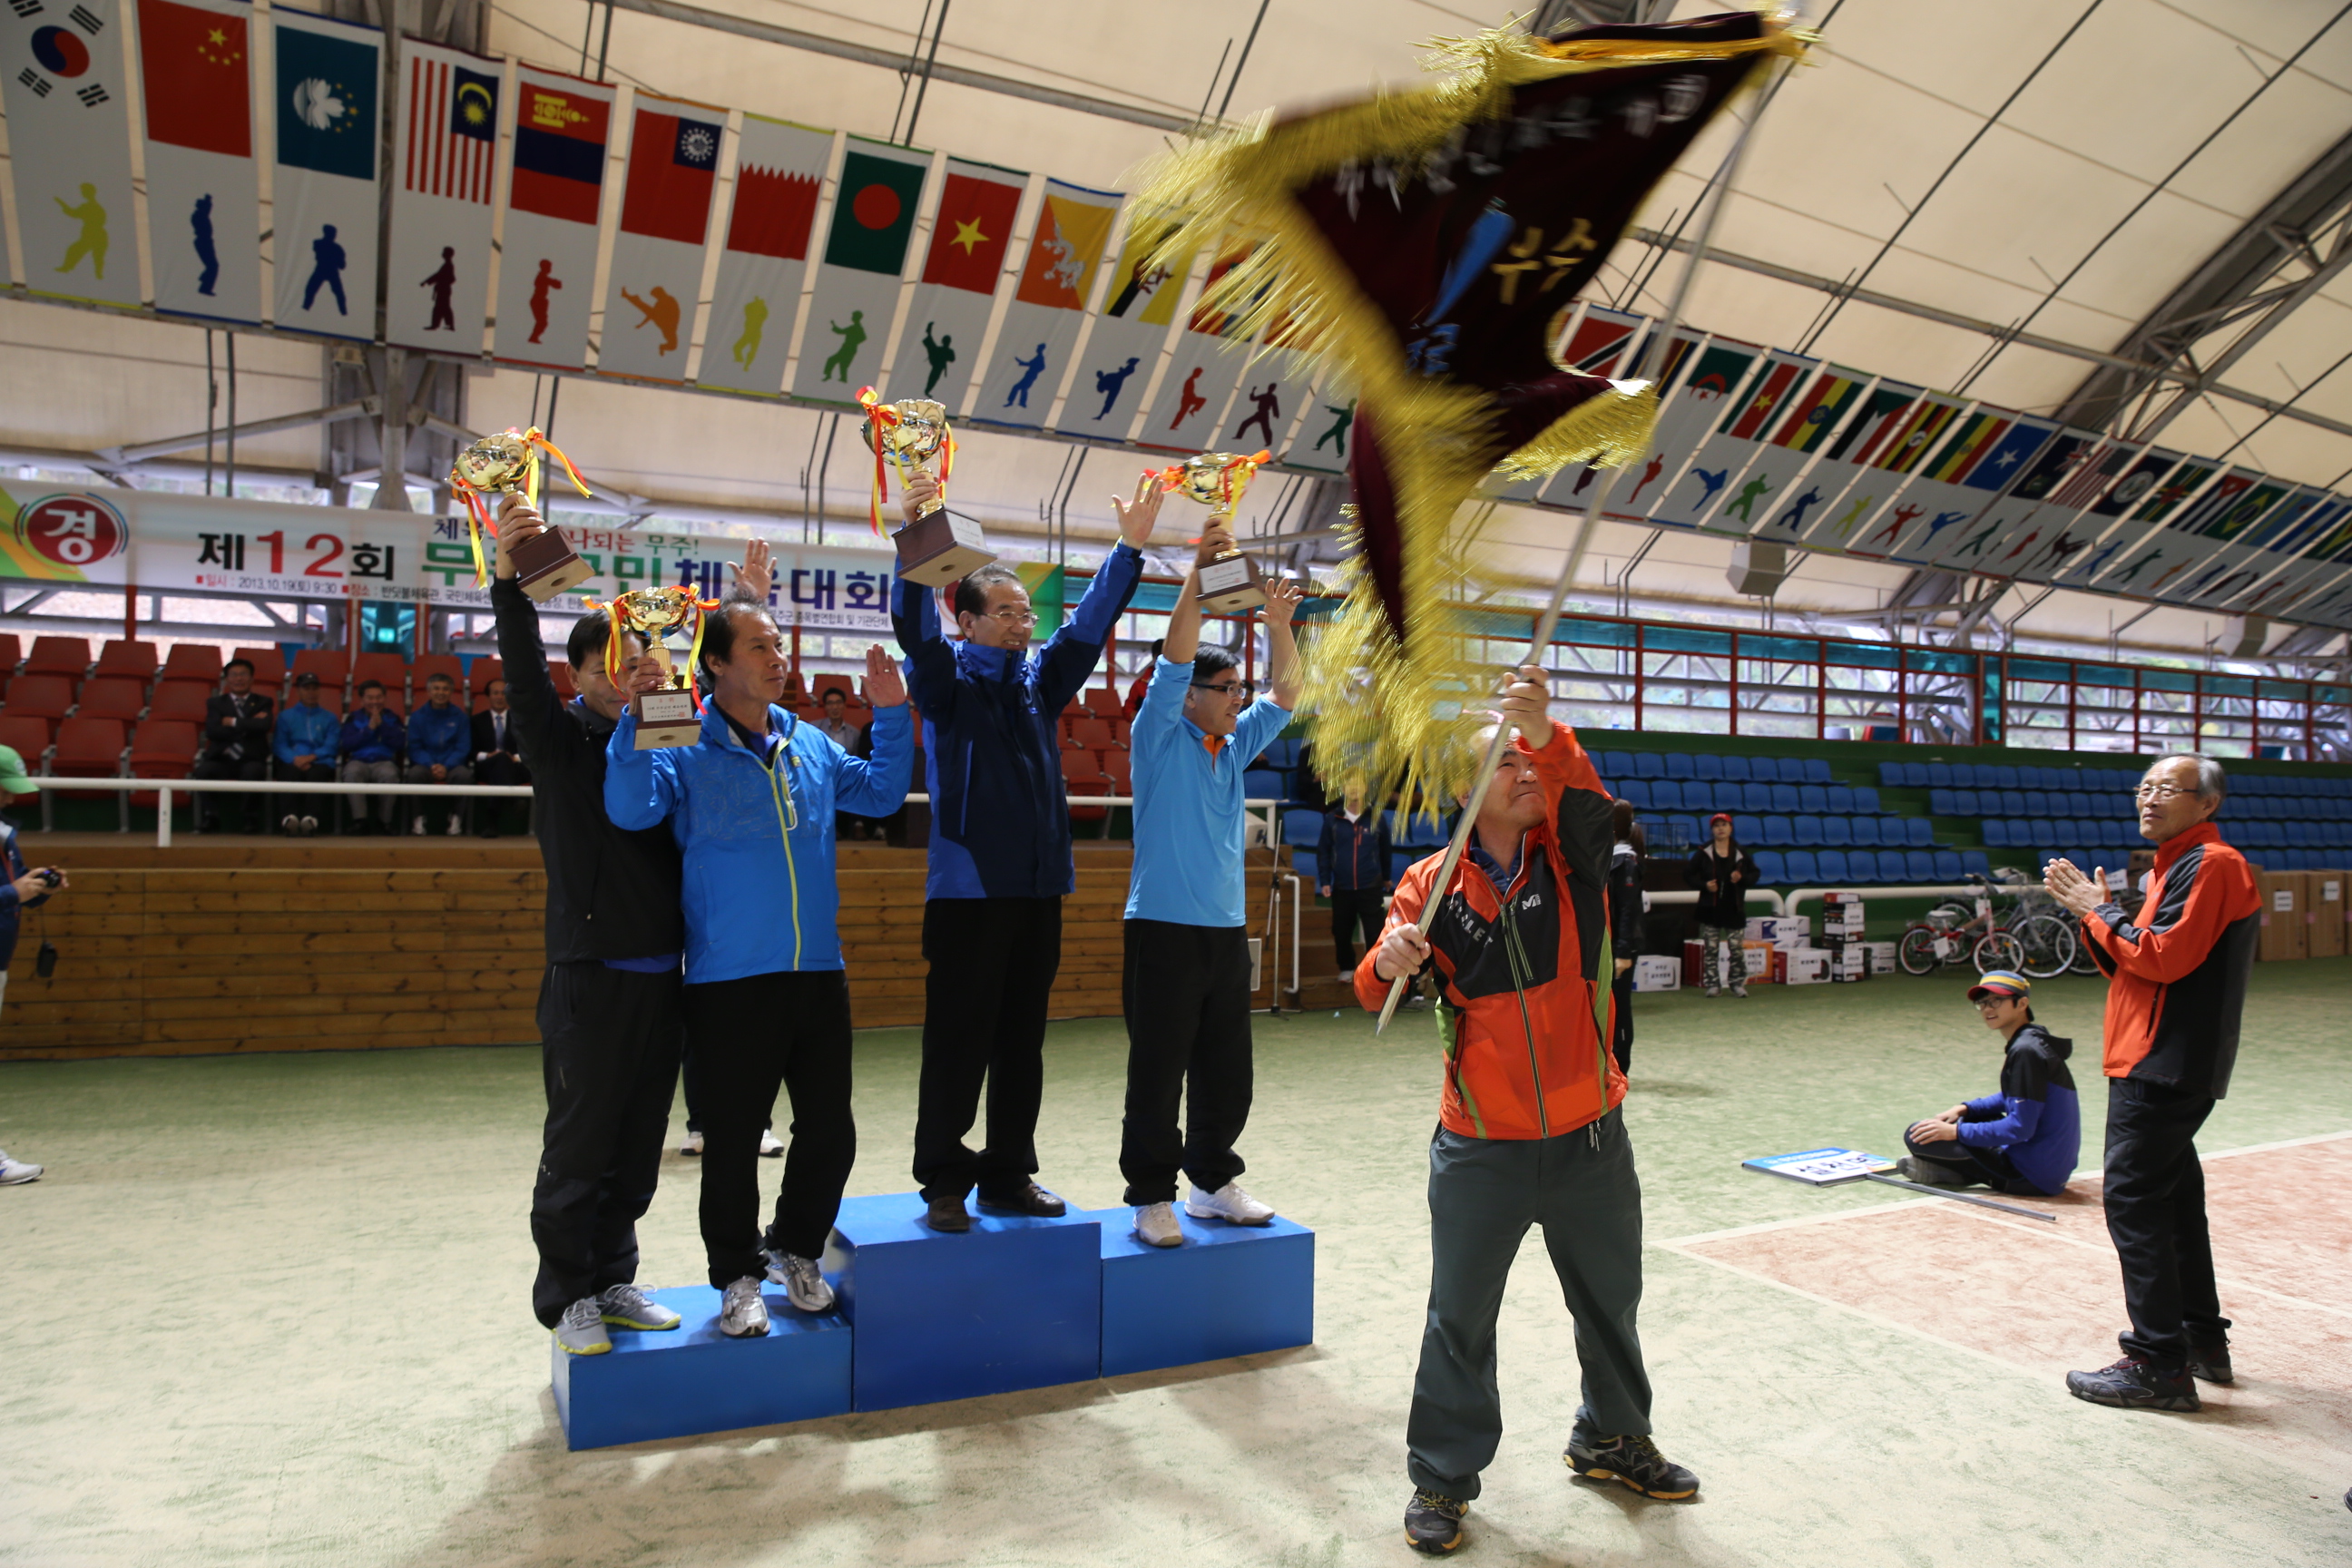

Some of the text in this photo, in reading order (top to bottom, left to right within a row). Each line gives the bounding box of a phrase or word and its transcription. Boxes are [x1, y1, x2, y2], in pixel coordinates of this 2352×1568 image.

[44, 509, 96, 563] 경
[569, 527, 635, 553] 나되는
[645, 534, 699, 557] 무주!
[674, 558, 889, 614] 체대회
